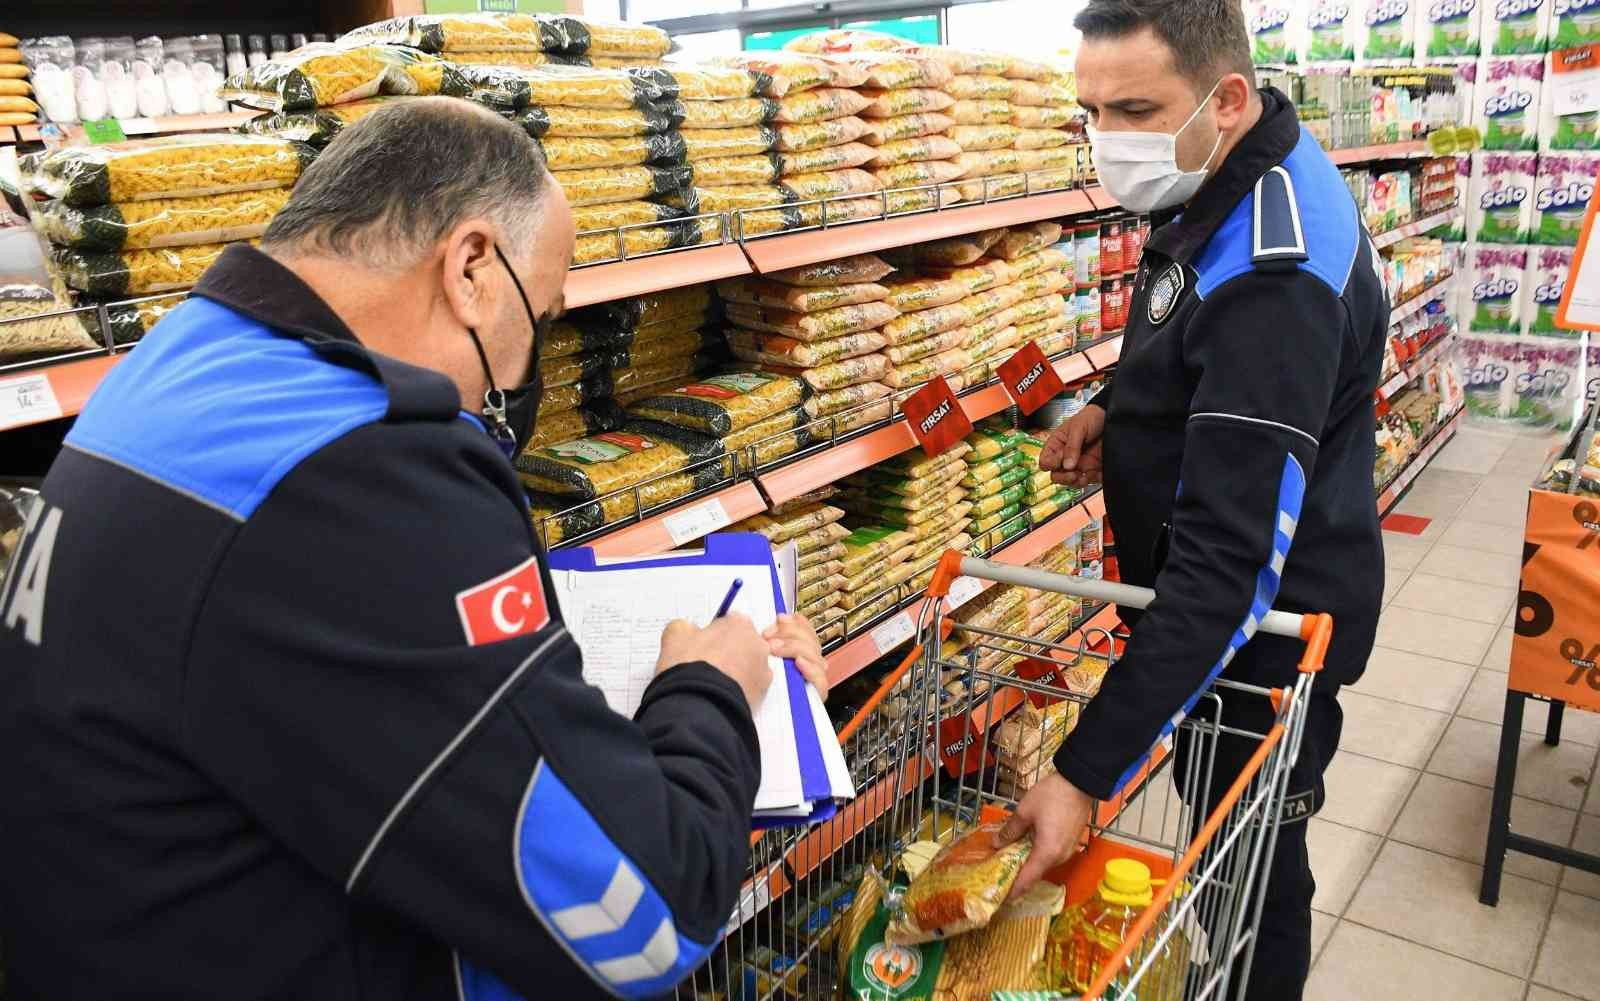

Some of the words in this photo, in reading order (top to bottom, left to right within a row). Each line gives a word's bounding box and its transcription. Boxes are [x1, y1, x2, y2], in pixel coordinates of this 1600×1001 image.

[1484, 89, 1532, 117] Solo
[1480, 185, 1527, 210] Solo
[1536, 181, 1596, 212] Solo
[1472, 279, 1518, 302] Solo
[1015, 362, 1046, 396] FIRSAT
[919, 398, 952, 435] FIRSAT
